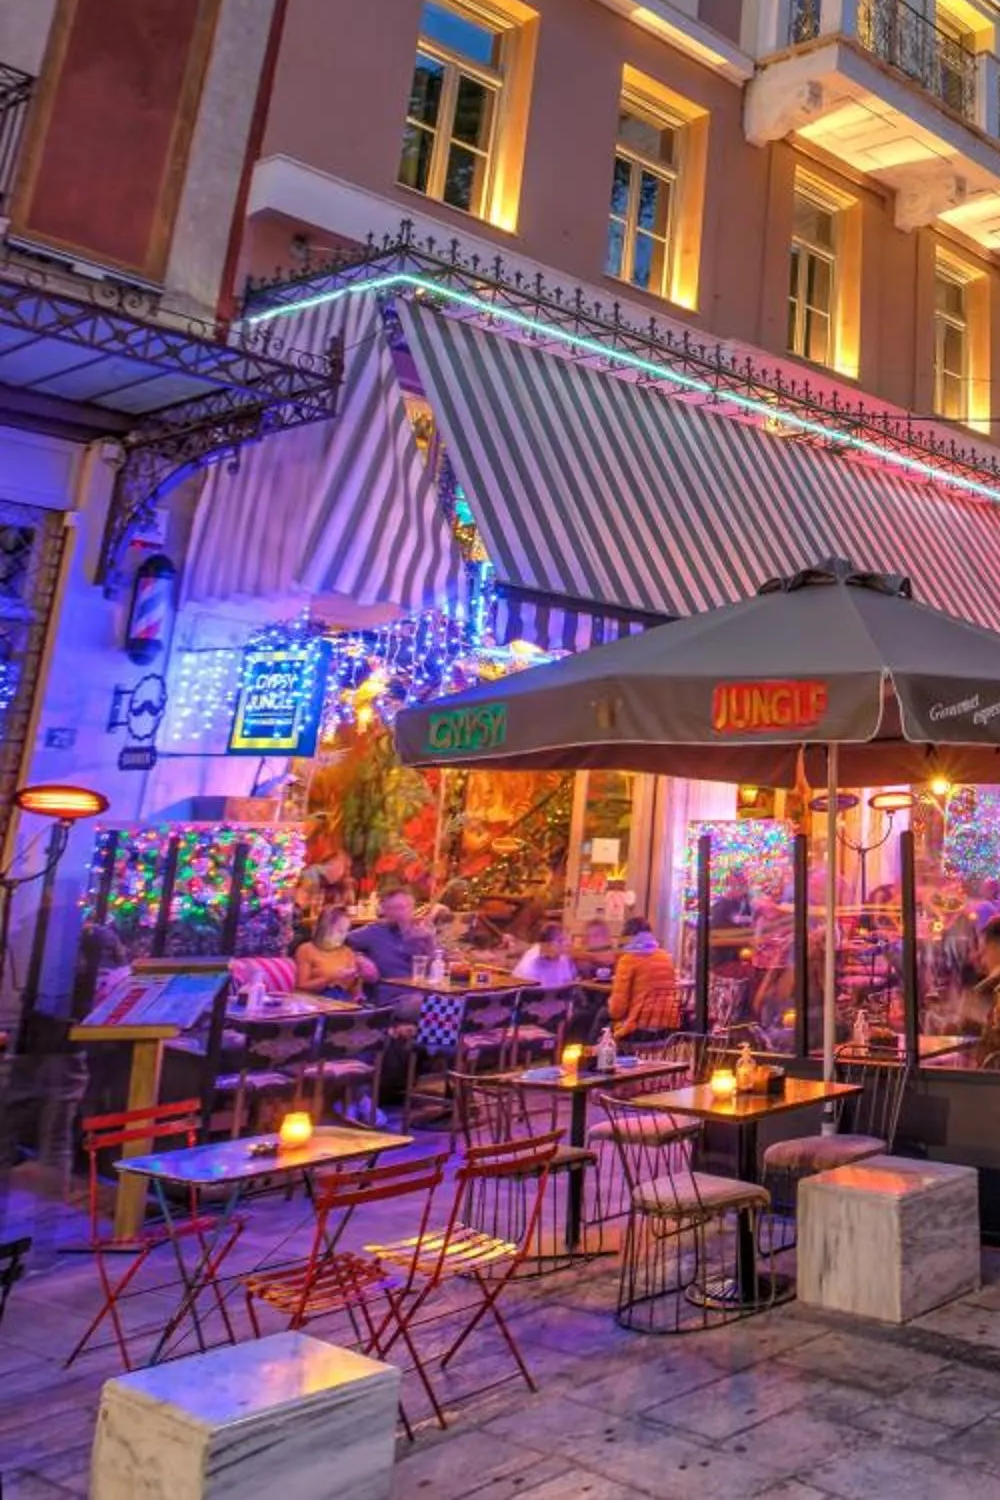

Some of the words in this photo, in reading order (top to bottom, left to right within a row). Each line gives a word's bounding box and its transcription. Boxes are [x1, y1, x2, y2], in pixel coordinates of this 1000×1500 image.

[256, 673, 299, 690] GYPSY
[245, 690, 297, 711] JUNGLE
[714, 683, 828, 730] JUNGLE
[429, 707, 507, 750] GYPSY
